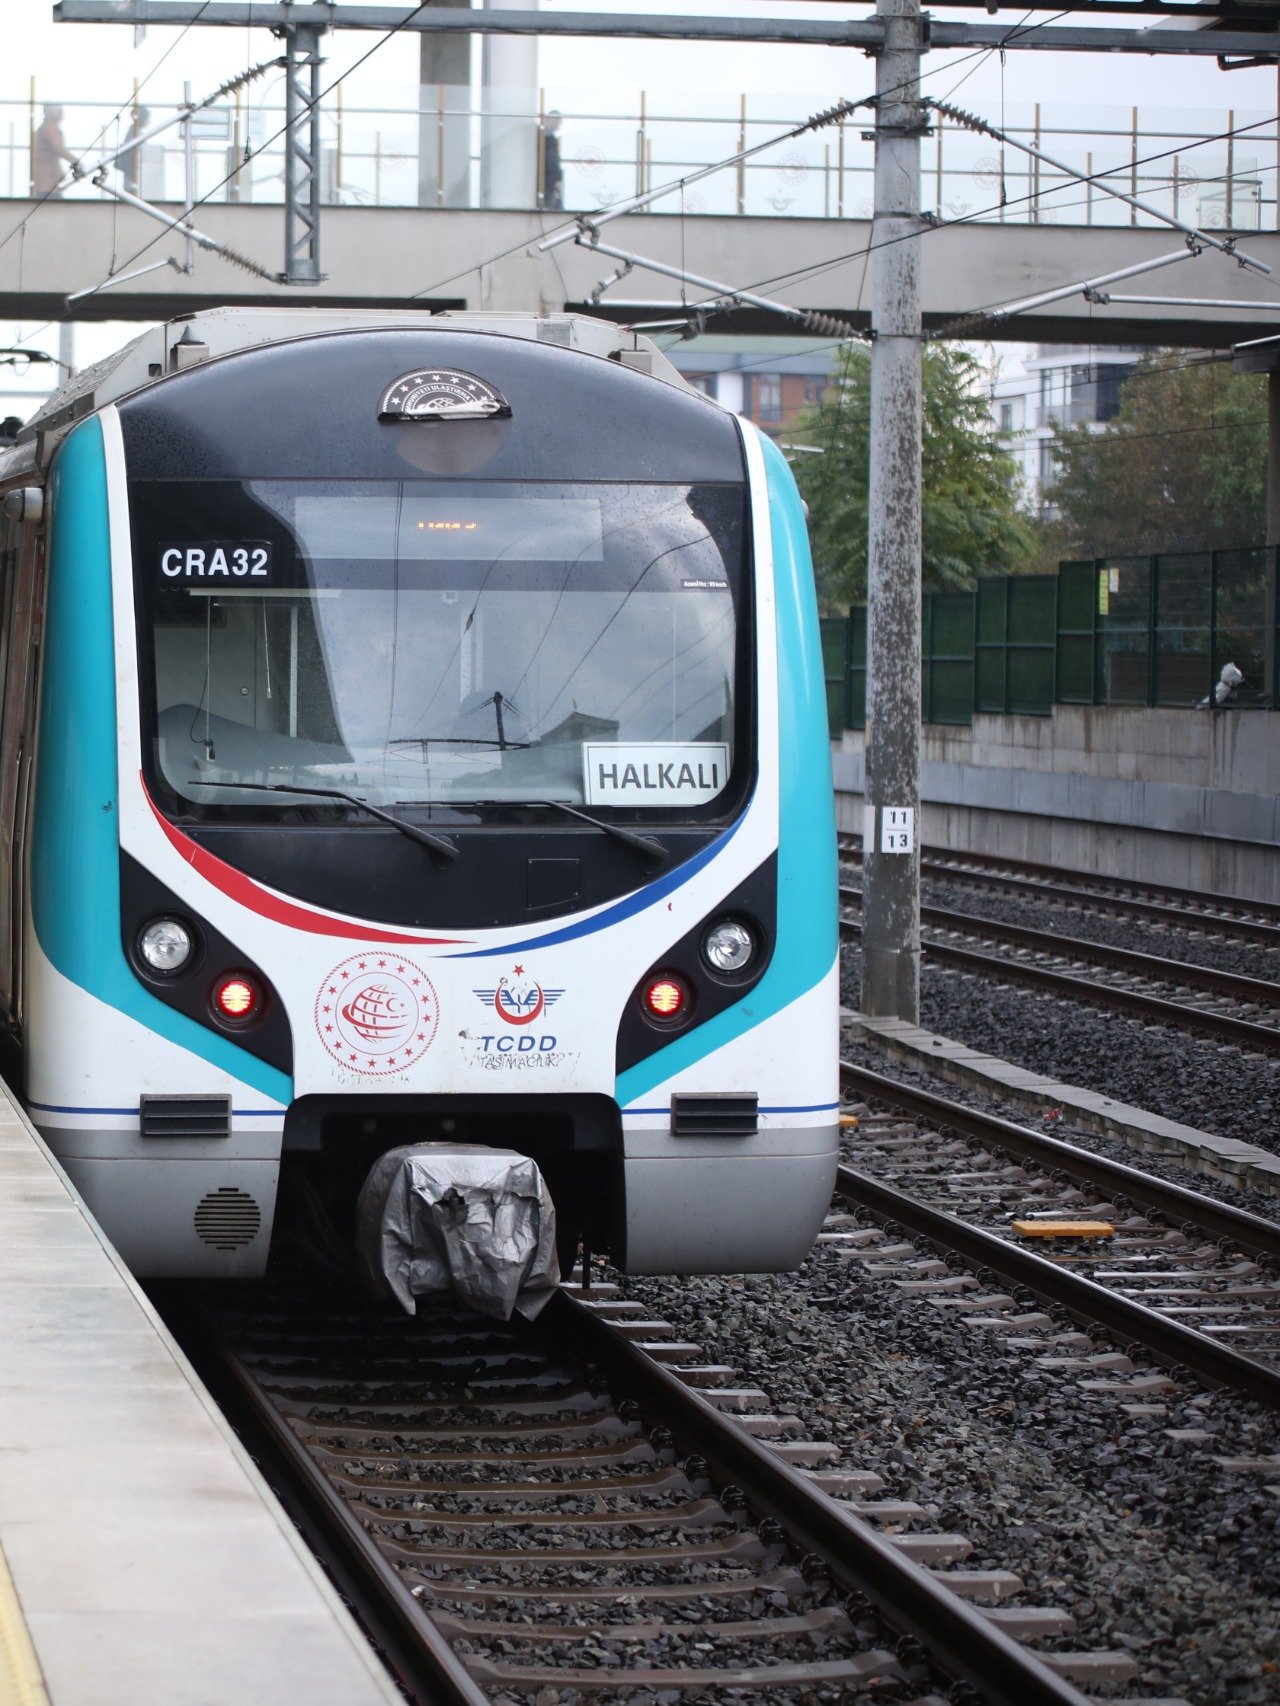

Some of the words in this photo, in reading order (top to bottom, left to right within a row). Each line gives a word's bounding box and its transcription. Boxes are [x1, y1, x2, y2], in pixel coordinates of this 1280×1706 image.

[162, 549, 268, 577] CRA32
[599, 763, 718, 789] HALKALI
[891, 812, 906, 824] 11
[888, 834, 907, 848] 13
[481, 1036, 557, 1052] TCDD
